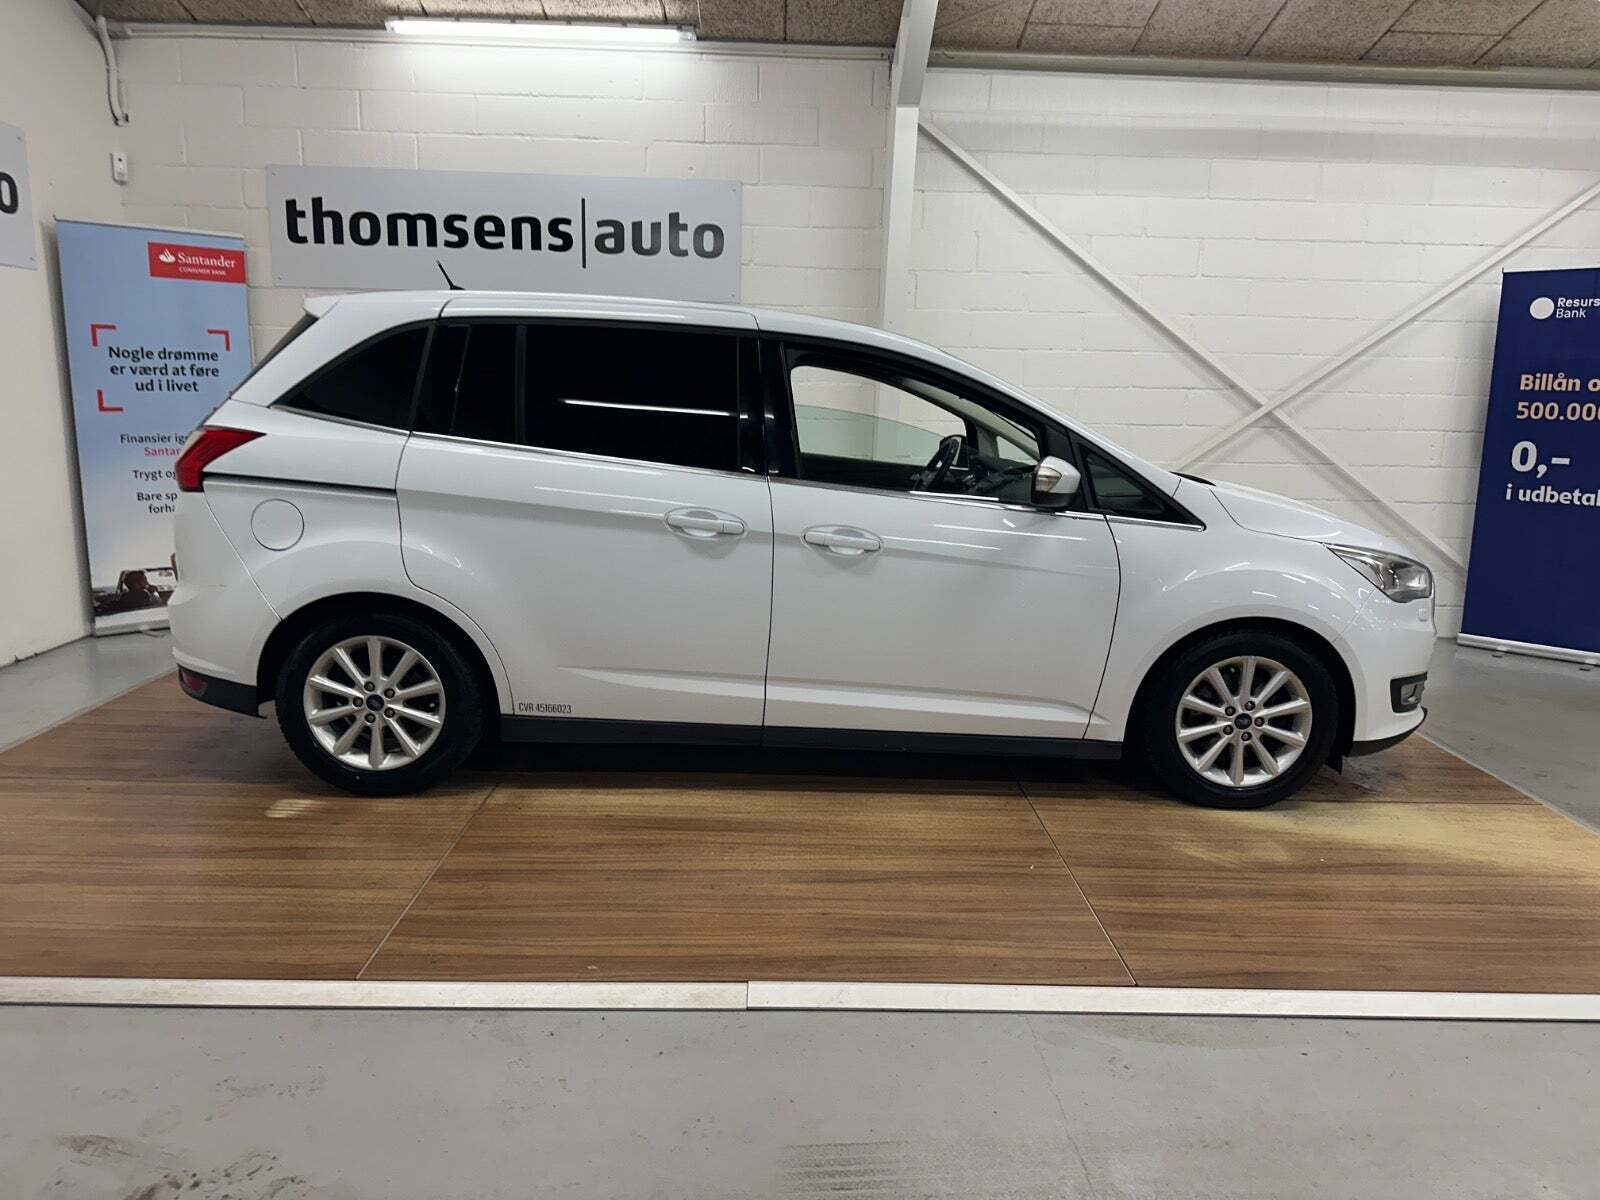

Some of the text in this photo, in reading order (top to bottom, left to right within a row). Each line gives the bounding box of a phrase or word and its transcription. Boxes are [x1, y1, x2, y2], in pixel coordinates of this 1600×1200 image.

[178, 252, 236, 268] Santander
[1557, 297, 1600, 307] Resurs
[1556, 308, 1586, 318] Bank
[108, 346, 218, 363] Nogle drømme
[110, 363, 219, 376] er værd at føre
[135, 380, 199, 392] ud i livet
[1520, 372, 1580, 391] Billån
[1516, 402, 1600, 421] 500.00
[120, 433, 171, 444] Finansier
[133, 469, 162, 481] Trygt
[137, 492, 161, 501] Bare
[1506, 483, 1512, 500] i
[518, 702, 572, 714] CVR 45166023
